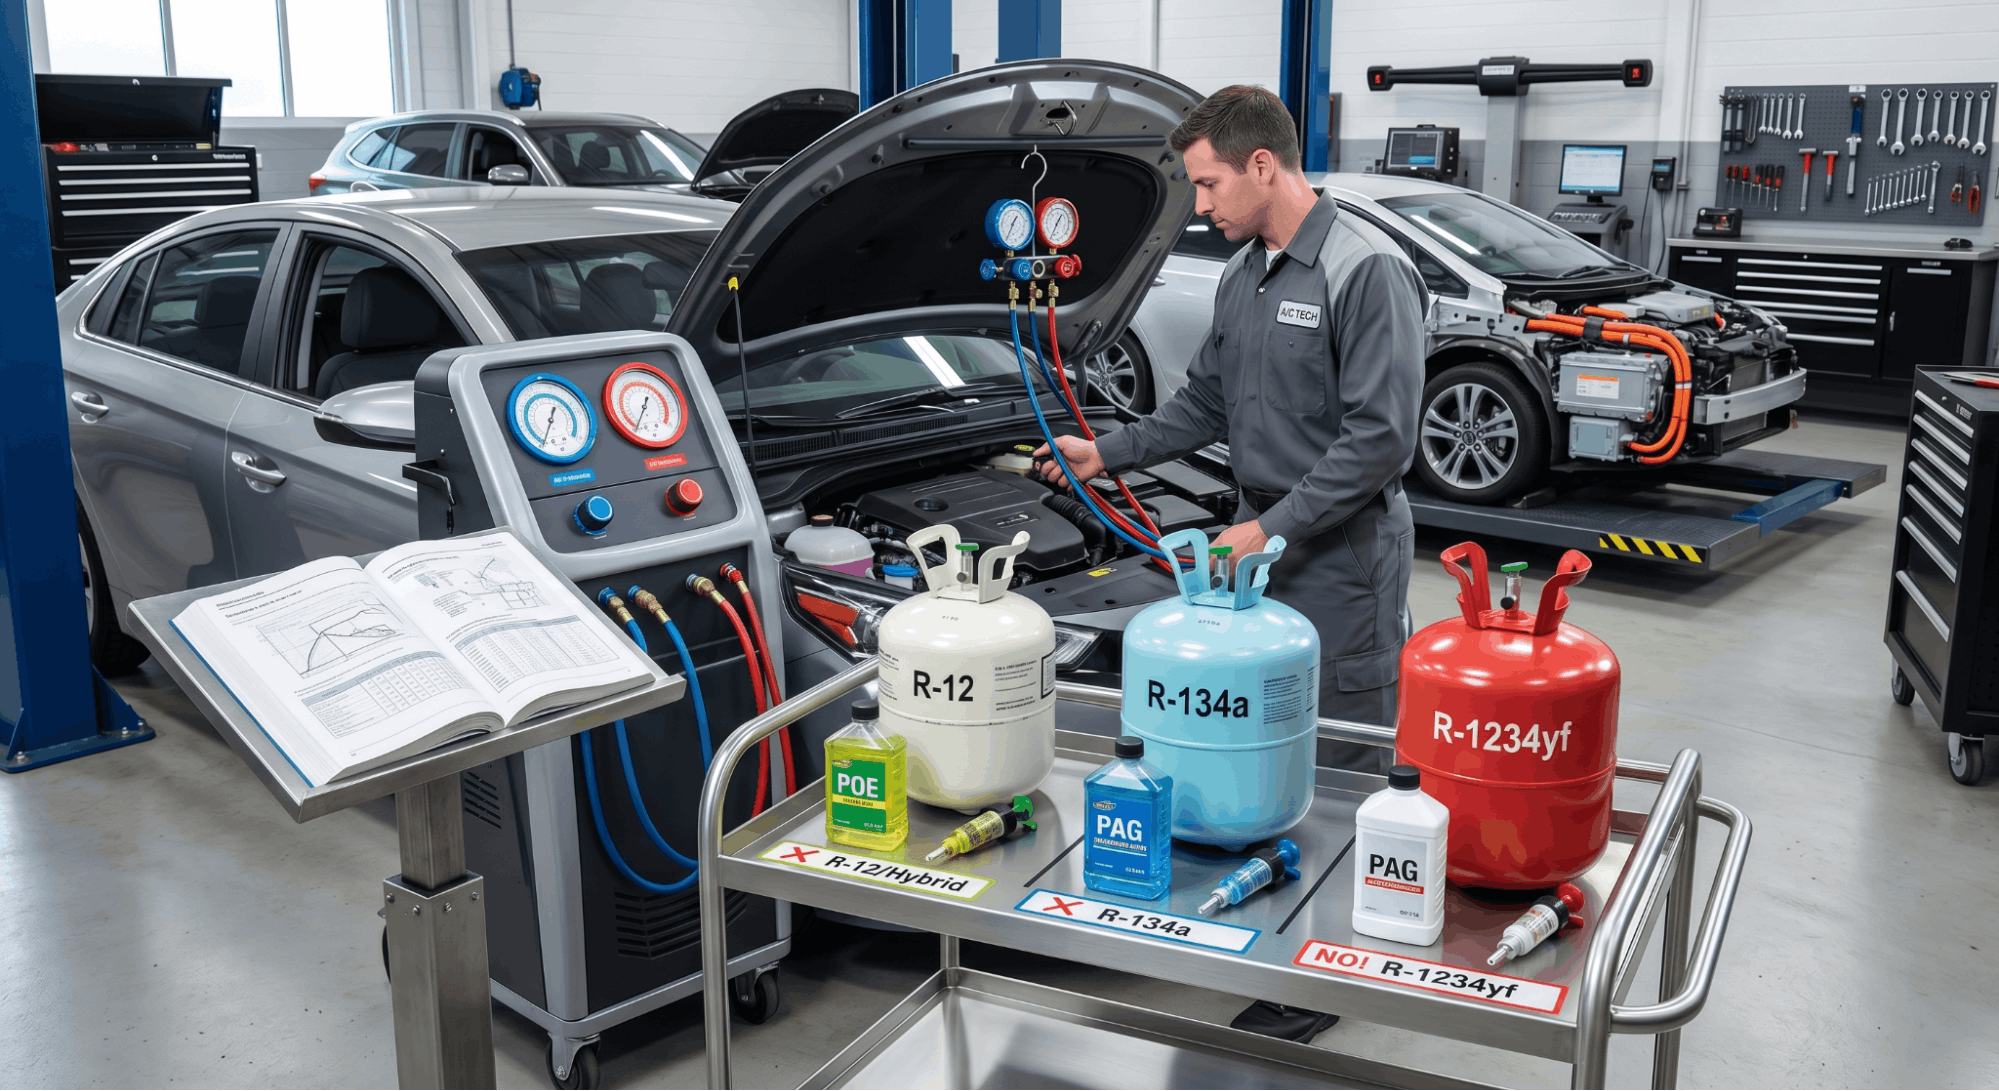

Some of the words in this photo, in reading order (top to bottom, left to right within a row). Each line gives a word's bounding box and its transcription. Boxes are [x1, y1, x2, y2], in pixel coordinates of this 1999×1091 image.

[1280, 307, 1294, 318] A/C
[1295, 308, 1318, 322] TECH
[913, 670, 974, 702] R-12
[1148, 679, 1249, 719] R-134a
[1433, 711, 1572, 761] R-1234yf
[837, 772, 879, 799] POE
[1097, 814, 1143, 842] PAG
[824, 855, 969, 893] R-12/Hybrid
[1370, 853, 1418, 882] PAG
[1097, 908, 1192, 938] R-134a
[1313, 948, 1370, 970] NO!
[1380, 961, 1519, 999] R-1234yf
